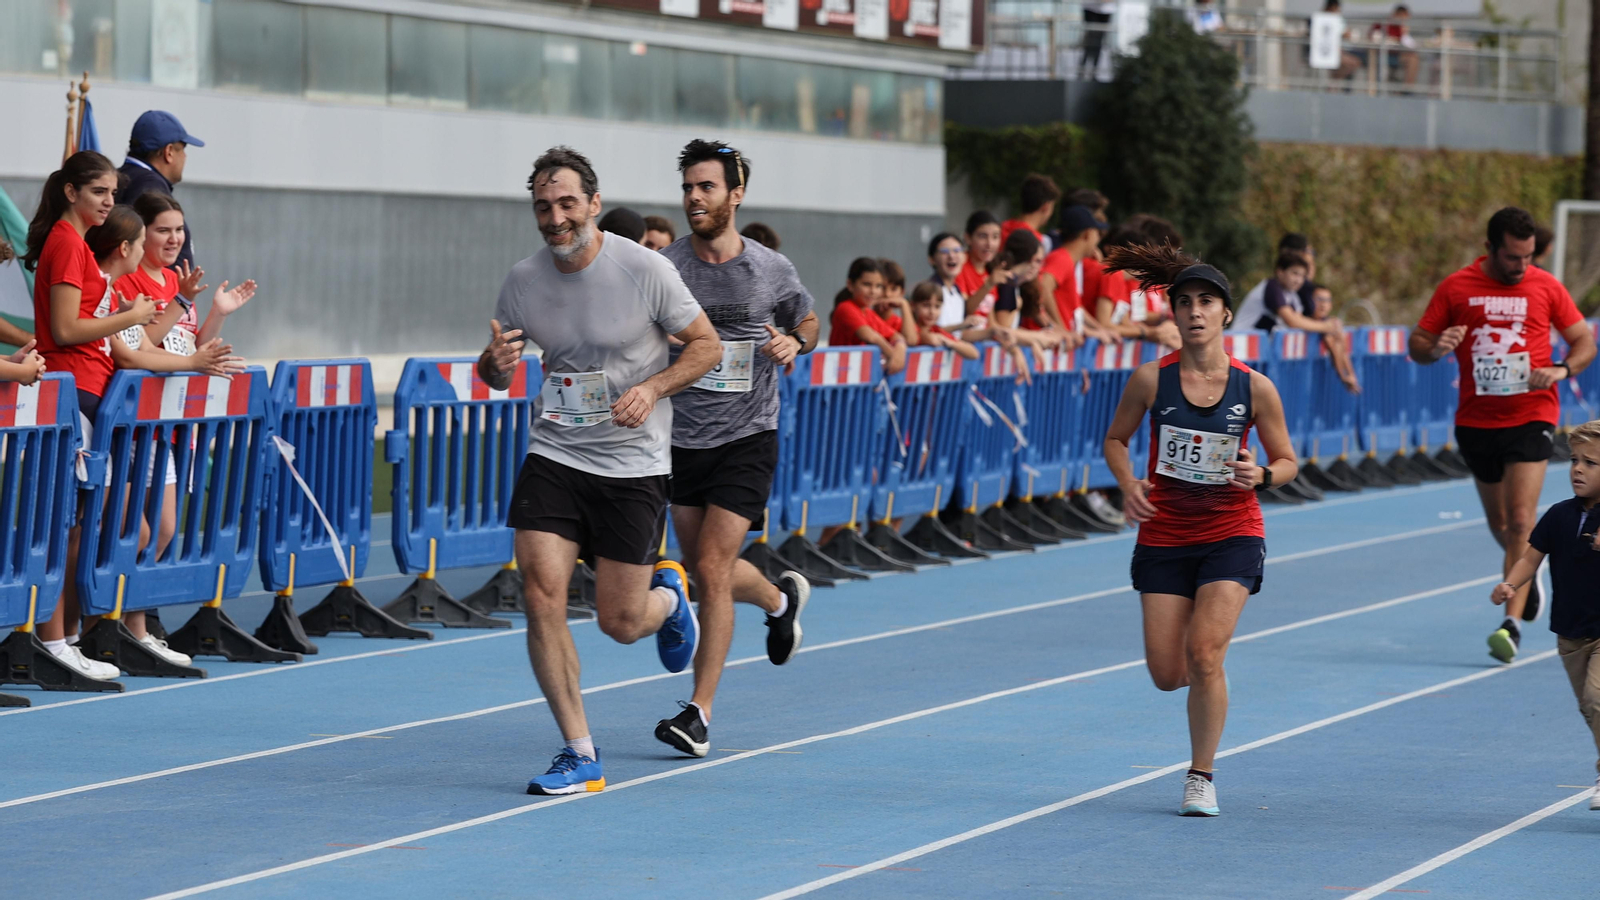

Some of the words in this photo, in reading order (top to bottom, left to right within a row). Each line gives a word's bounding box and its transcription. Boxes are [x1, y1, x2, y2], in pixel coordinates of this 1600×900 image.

[1476, 366, 1507, 380] 1027
[556, 388, 565, 406] 1
[1166, 440, 1202, 464] 915
